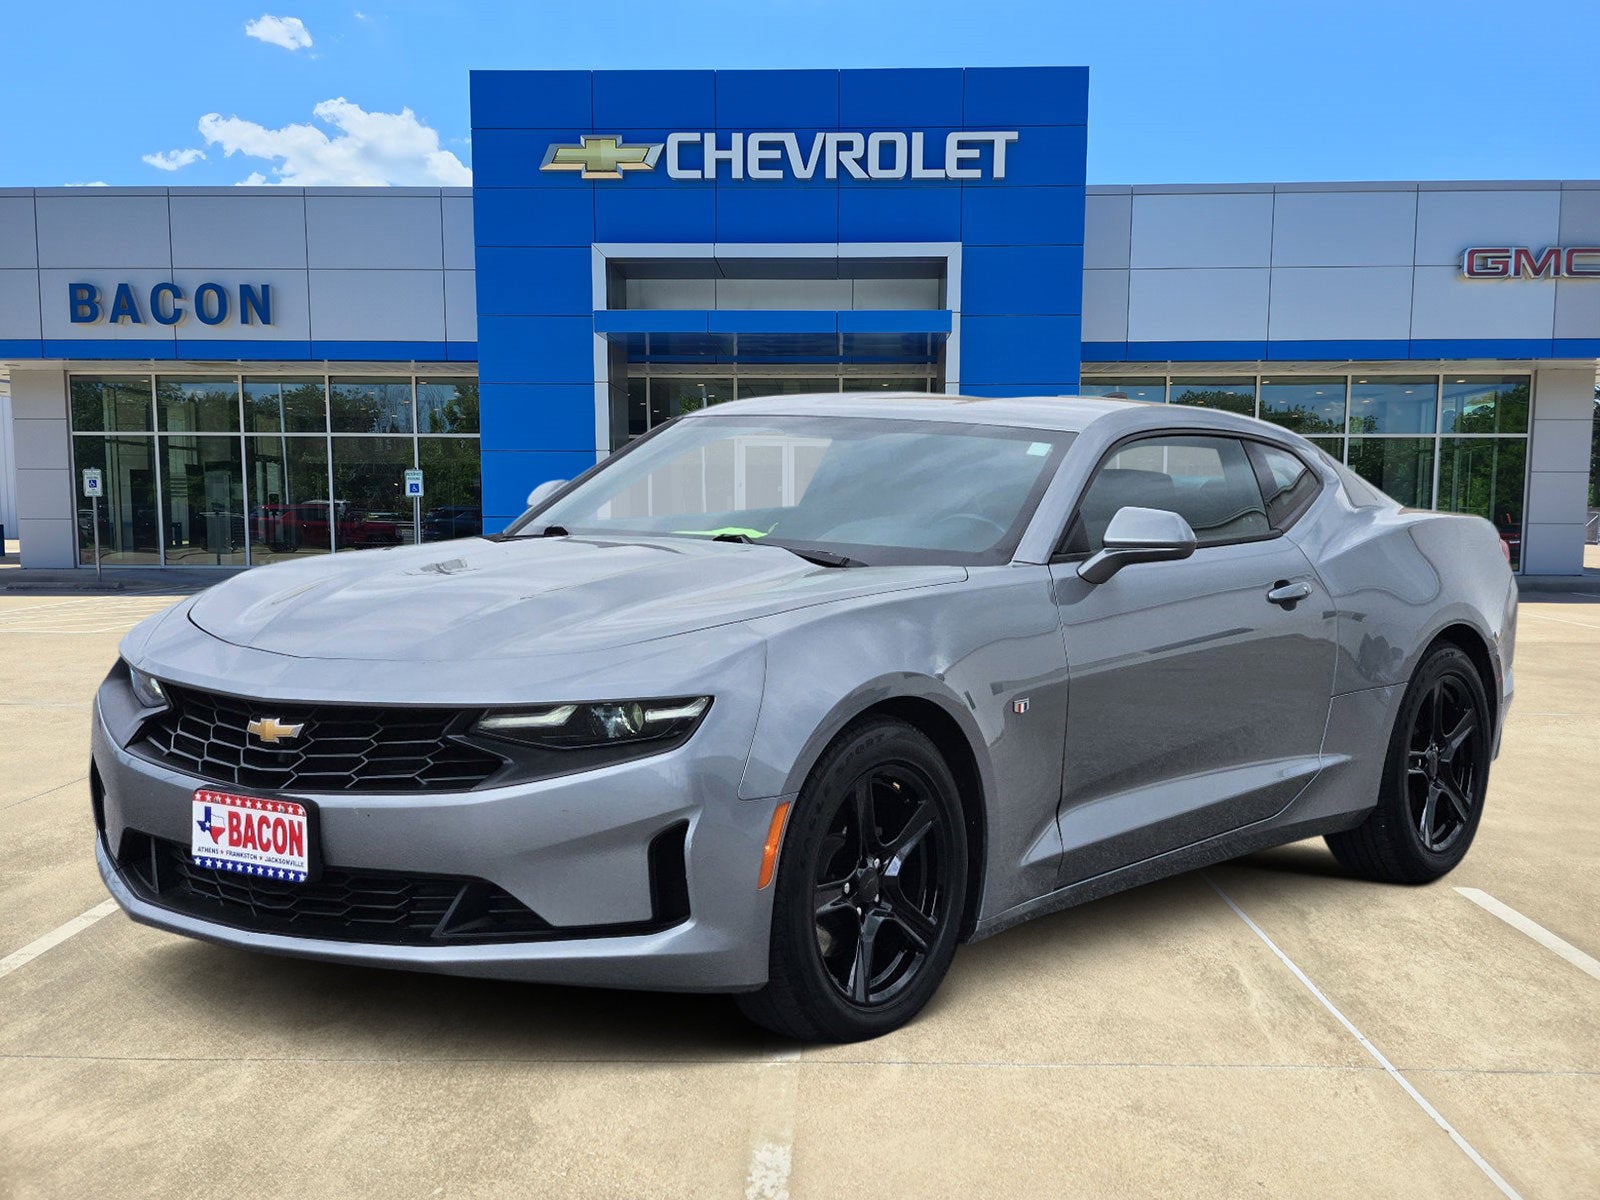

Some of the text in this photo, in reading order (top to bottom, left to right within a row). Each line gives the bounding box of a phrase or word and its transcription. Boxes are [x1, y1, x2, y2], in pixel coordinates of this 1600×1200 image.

[666, 131, 1018, 181] CHEVROLET
[1463, 247, 1600, 278] GMC
[69, 282, 273, 326] BACON
[228, 811, 304, 858] BACON
[197, 846, 304, 868] ATHENS FRANKSTON JACKSONVILLE
